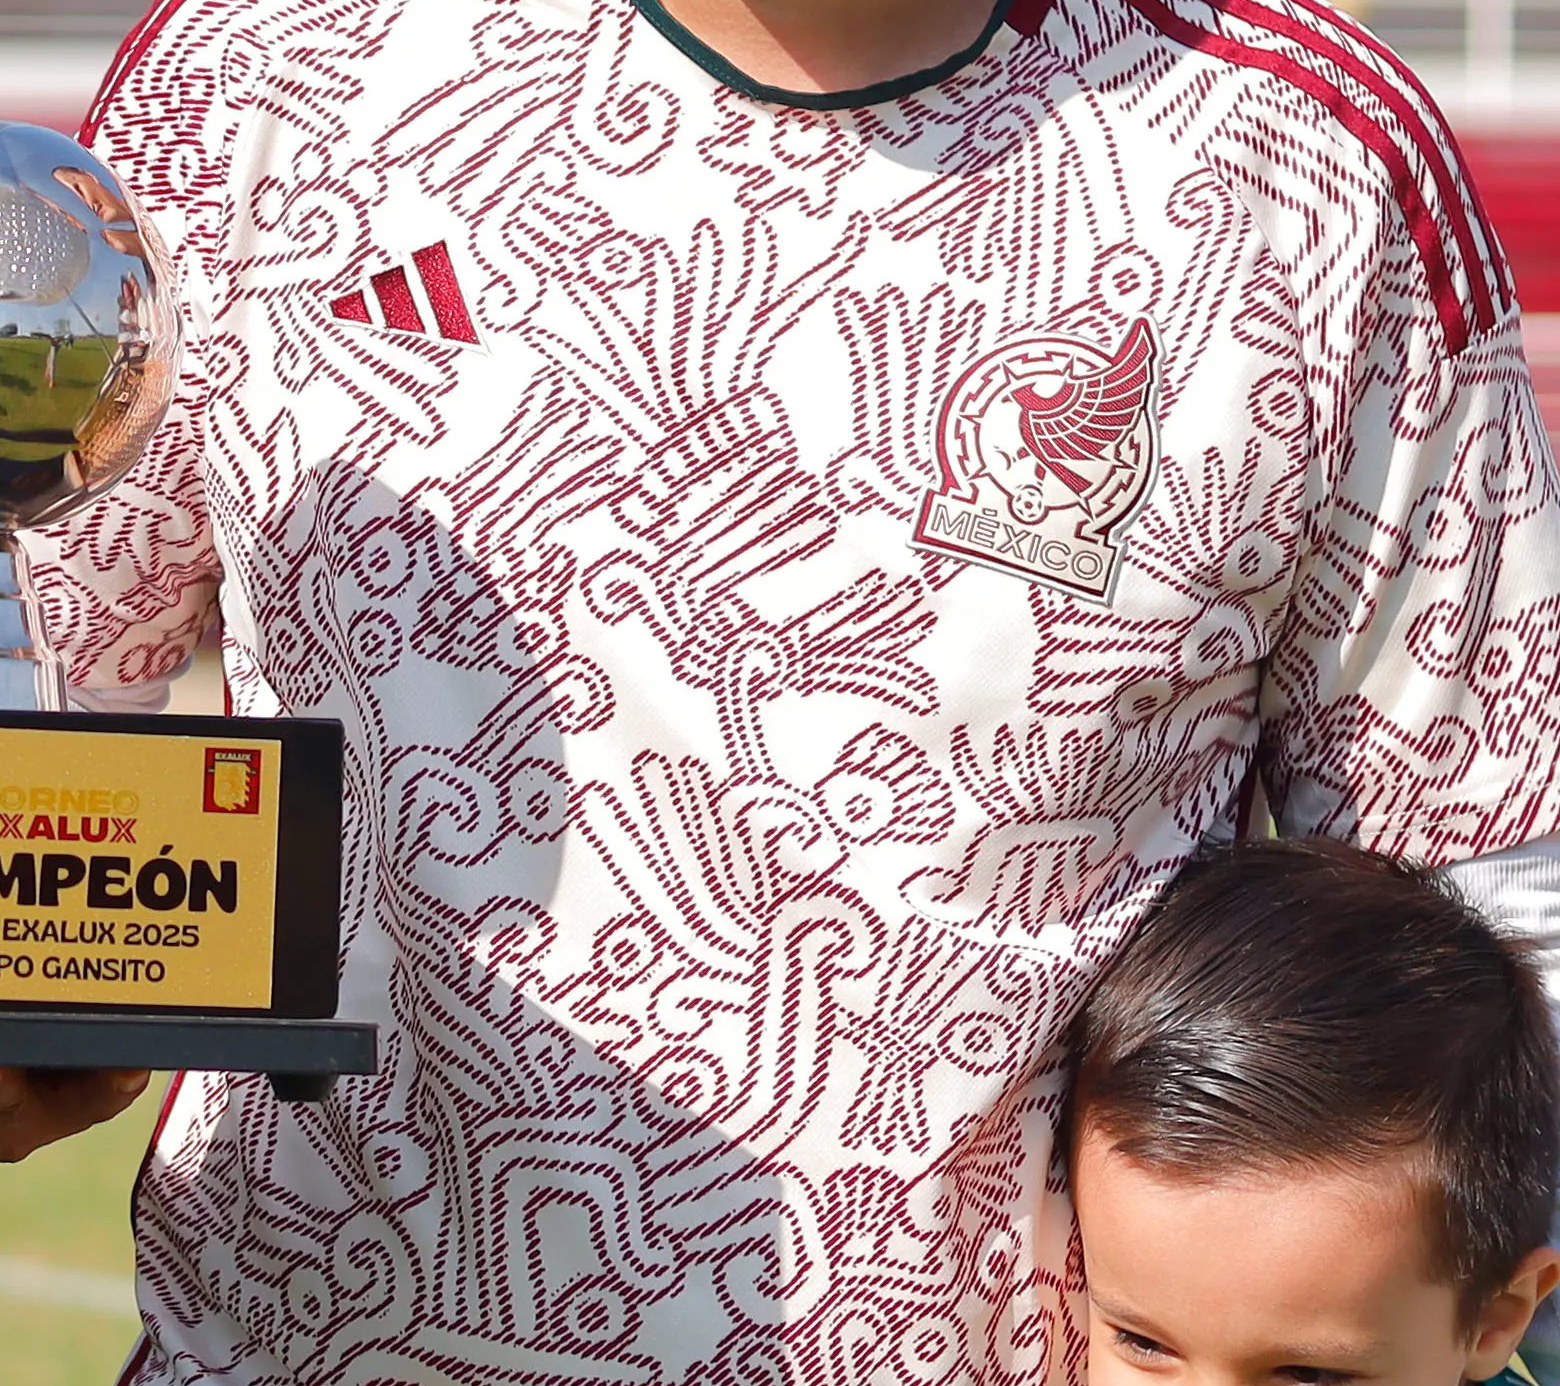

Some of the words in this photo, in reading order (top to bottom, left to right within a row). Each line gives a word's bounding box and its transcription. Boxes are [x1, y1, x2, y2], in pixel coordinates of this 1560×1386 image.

[931, 503, 1103, 580] MÉXICO
[2, 918, 116, 945] EXALUX
[123, 923, 200, 947] 2025
[42, 956, 166, 982] GANSITO
